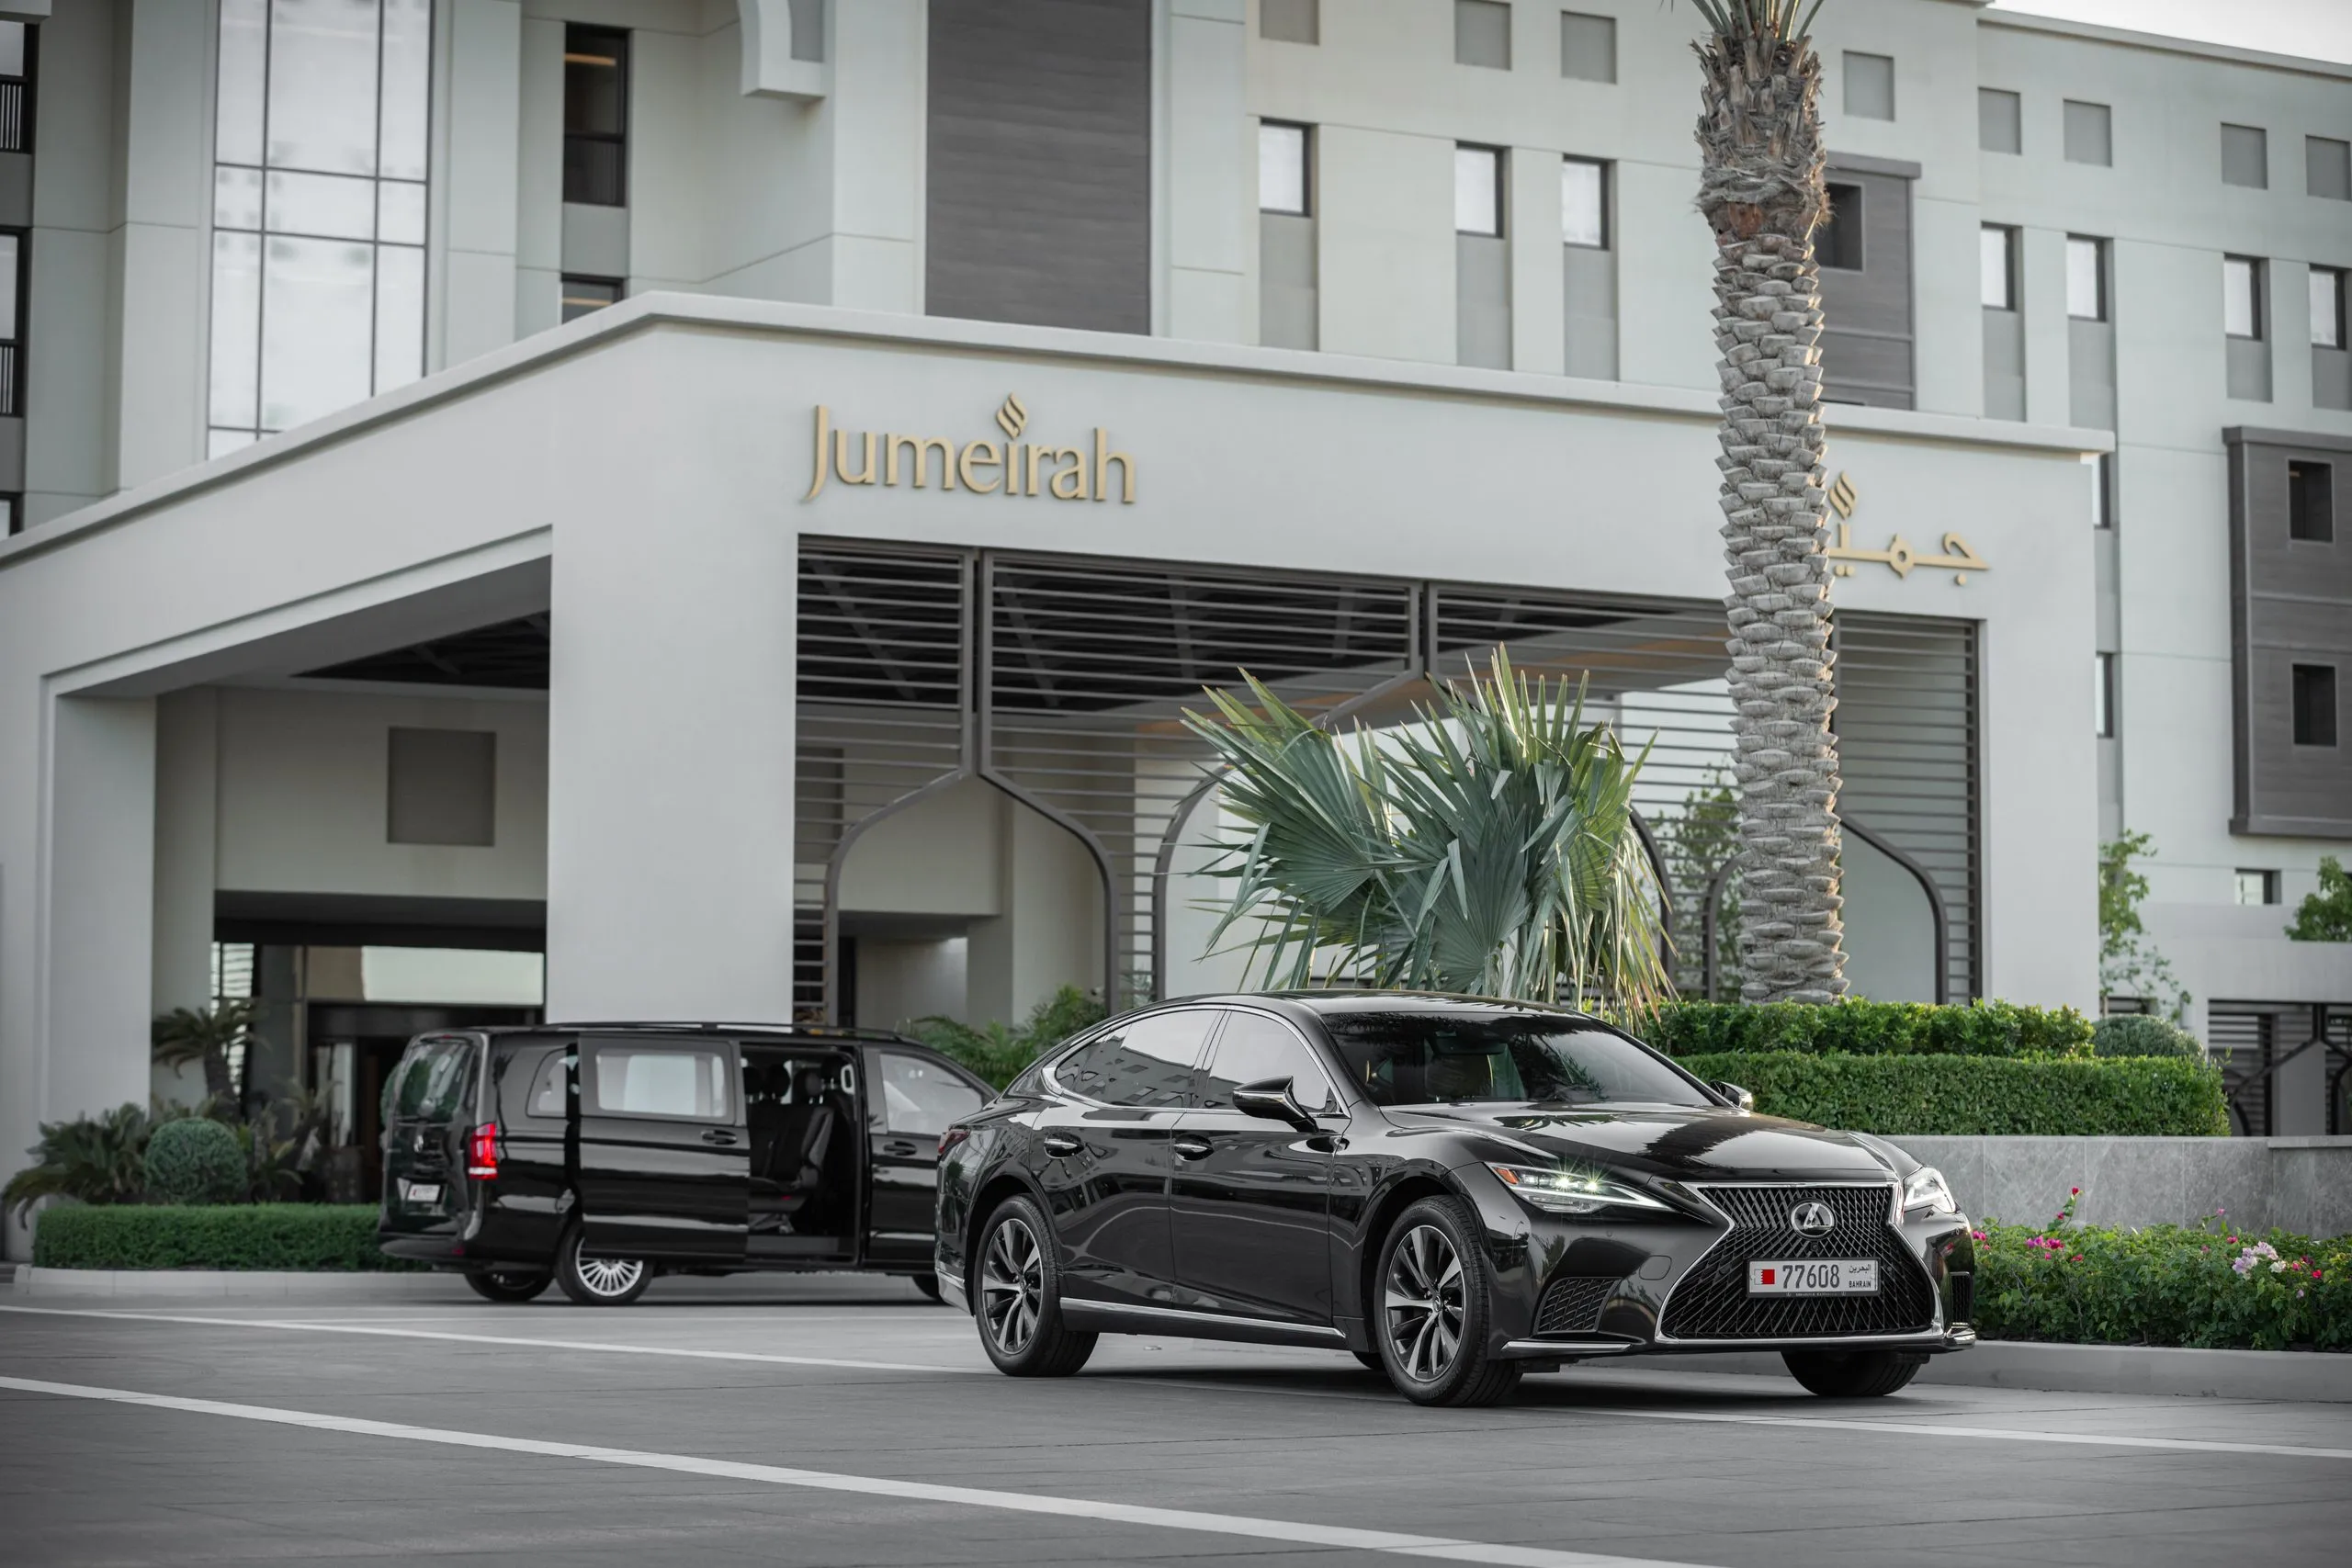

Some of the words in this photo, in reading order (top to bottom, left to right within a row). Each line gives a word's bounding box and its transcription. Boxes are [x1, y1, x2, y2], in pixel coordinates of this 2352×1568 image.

[801, 394, 1136, 505] Jumeirah
[1781, 1264, 1840, 1290] 77608
[1849, 1264, 1871, 1274] البحرين
[1849, 1280, 1871, 1289] BAHRAIN
